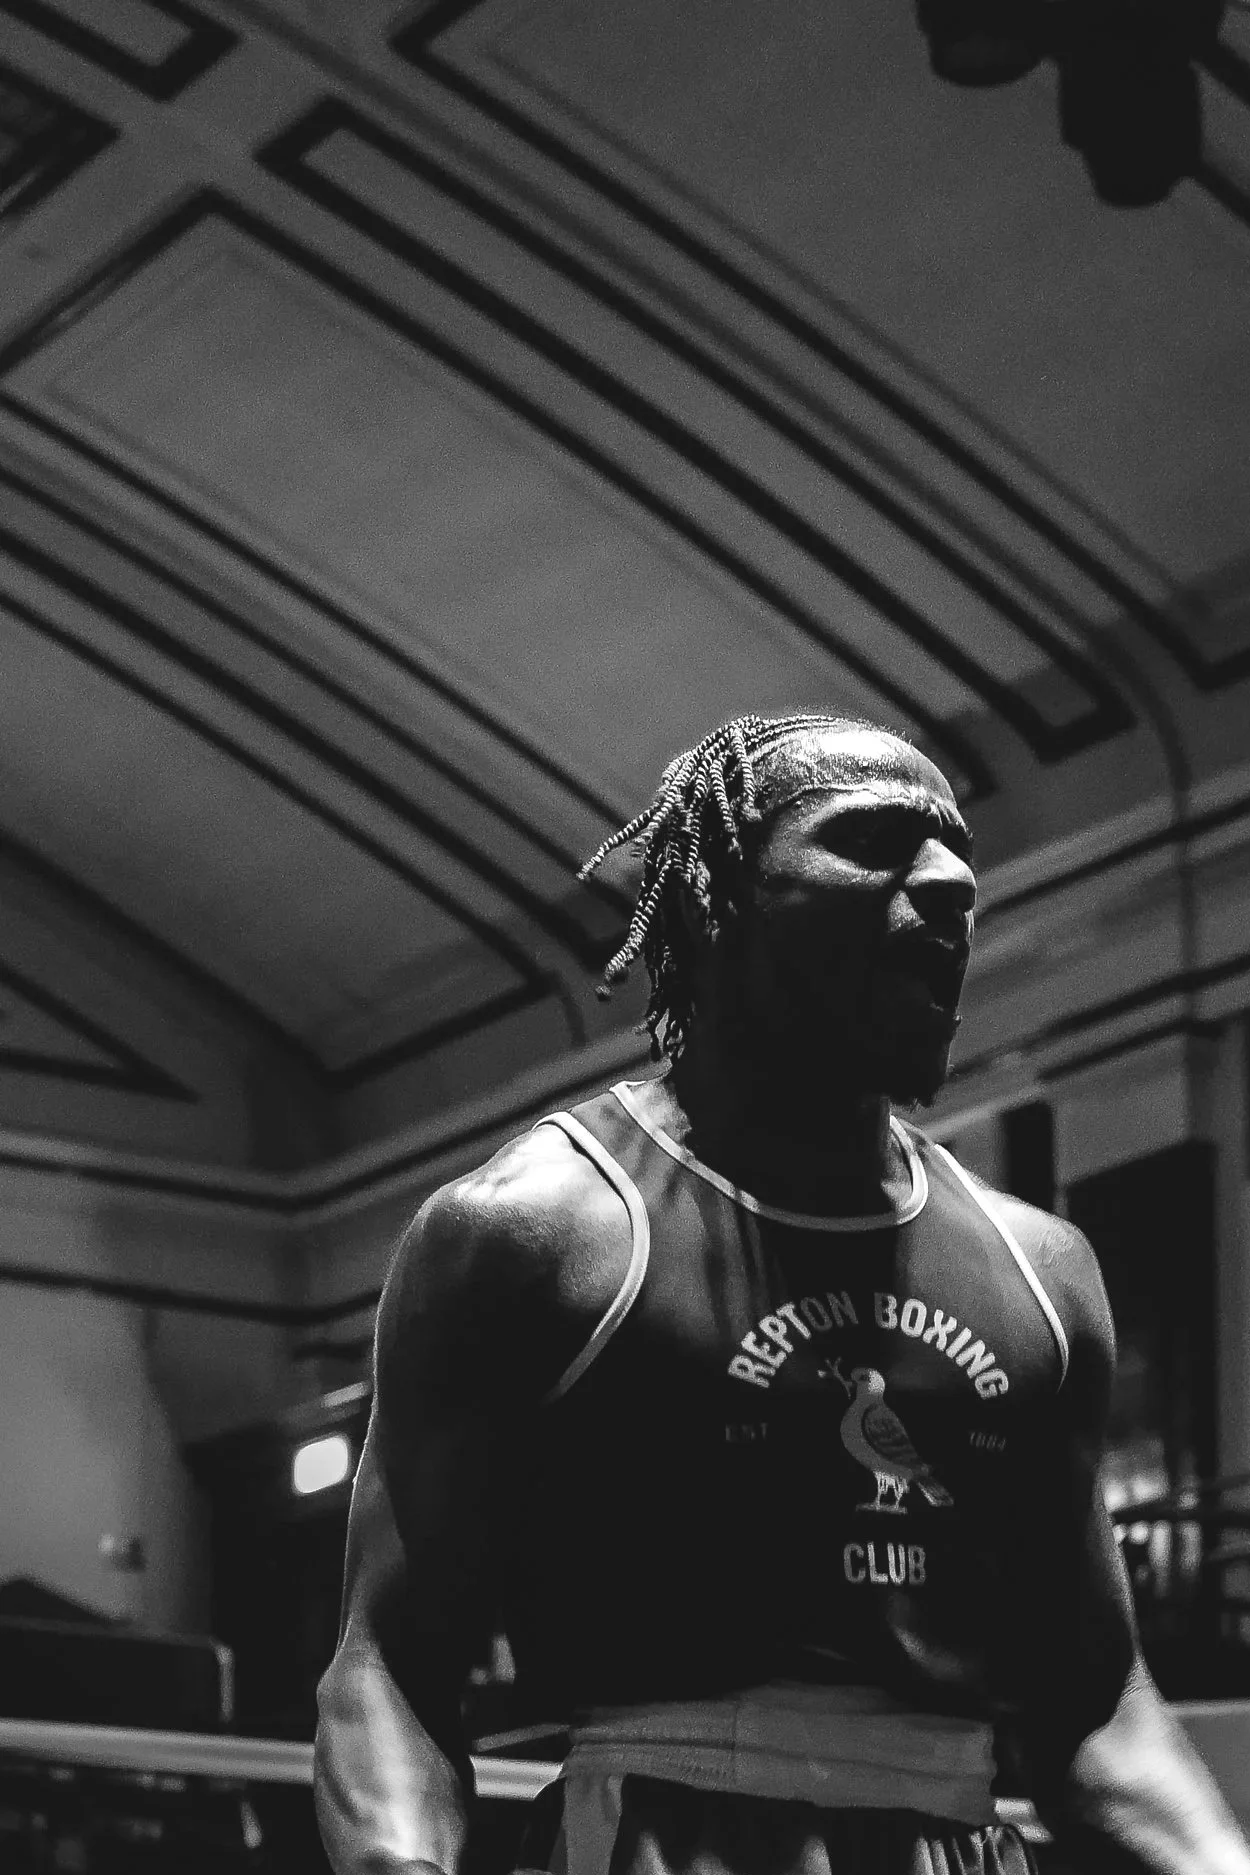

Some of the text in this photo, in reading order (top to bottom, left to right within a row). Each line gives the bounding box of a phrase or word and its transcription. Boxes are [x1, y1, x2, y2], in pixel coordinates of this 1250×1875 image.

[727, 1291, 1010, 1399] REPTON BOXING
[843, 1541, 927, 1586] CLUB
